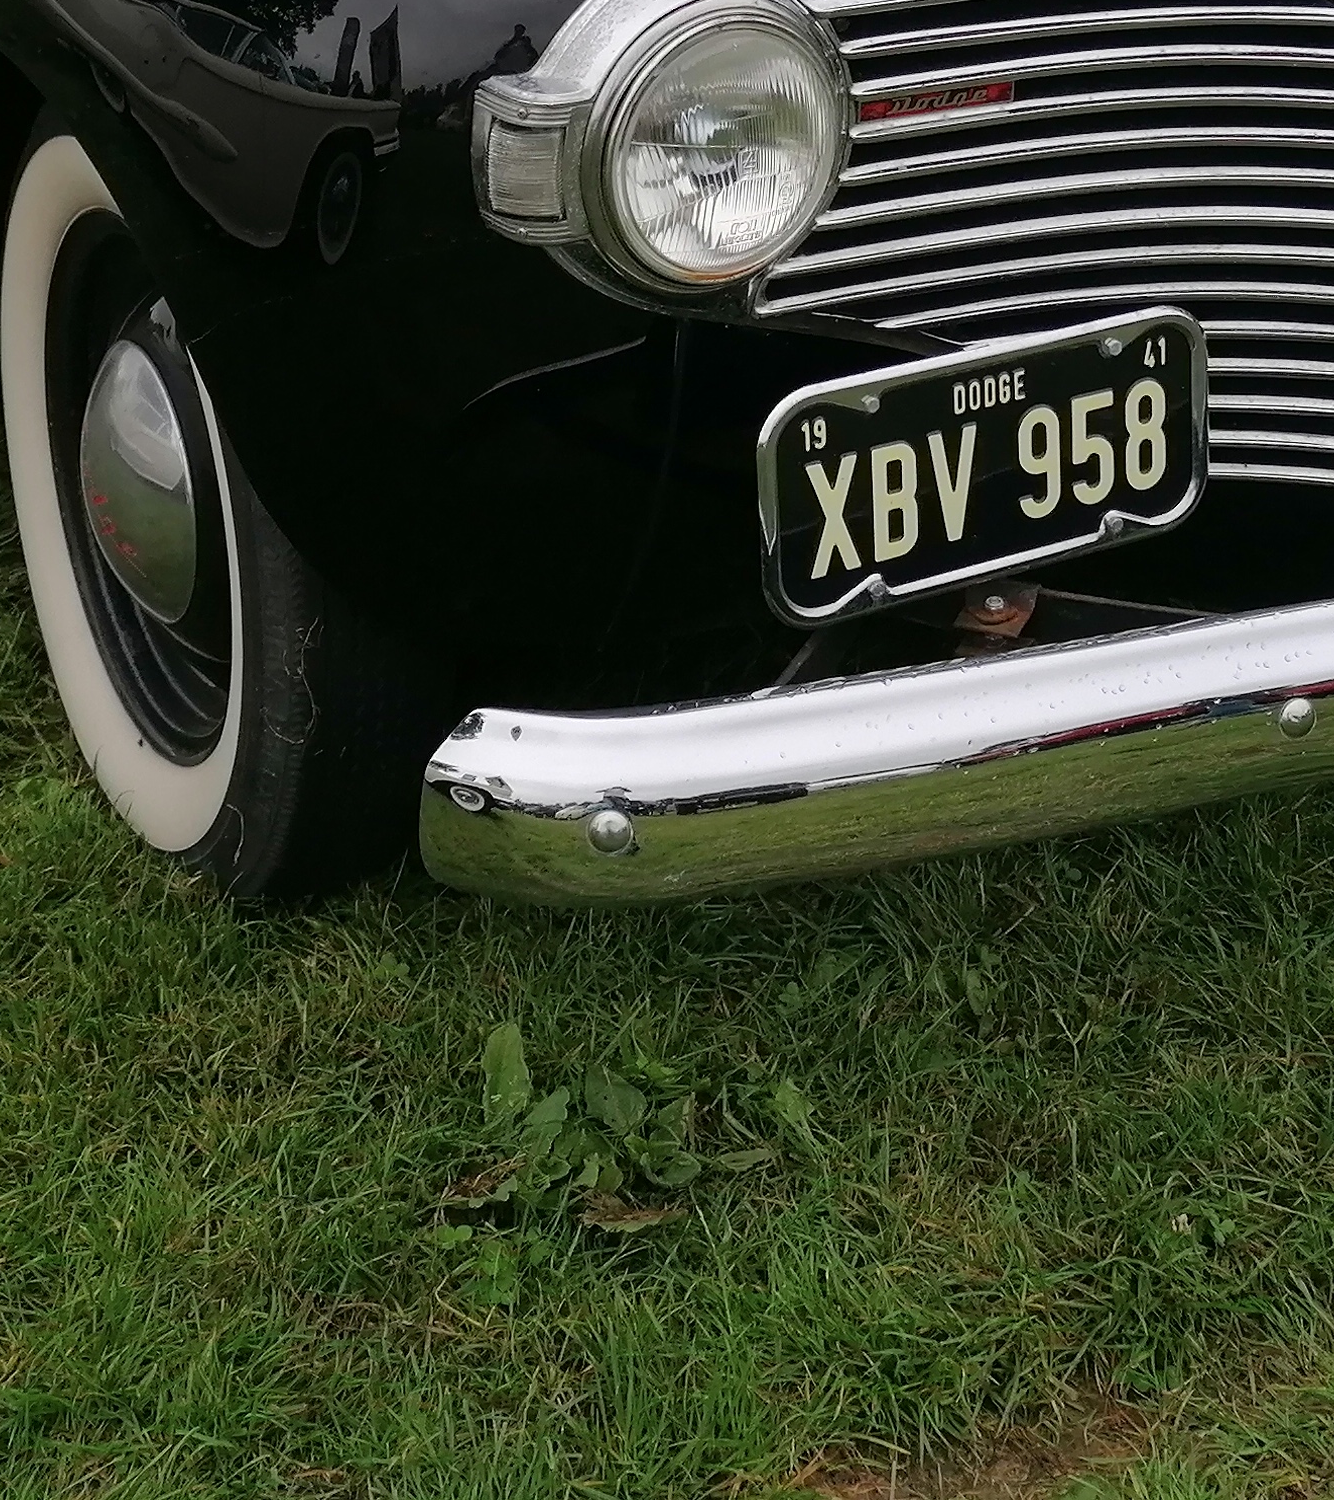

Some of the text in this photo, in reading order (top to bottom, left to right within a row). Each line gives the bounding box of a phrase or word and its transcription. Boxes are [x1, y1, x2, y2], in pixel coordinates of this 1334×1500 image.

[886, 88, 988, 115] Dodge
[800, 336, 1167, 452] 19 41
[953, 368, 1027, 415] DODGE
[804, 377, 1167, 580] XBV 958
